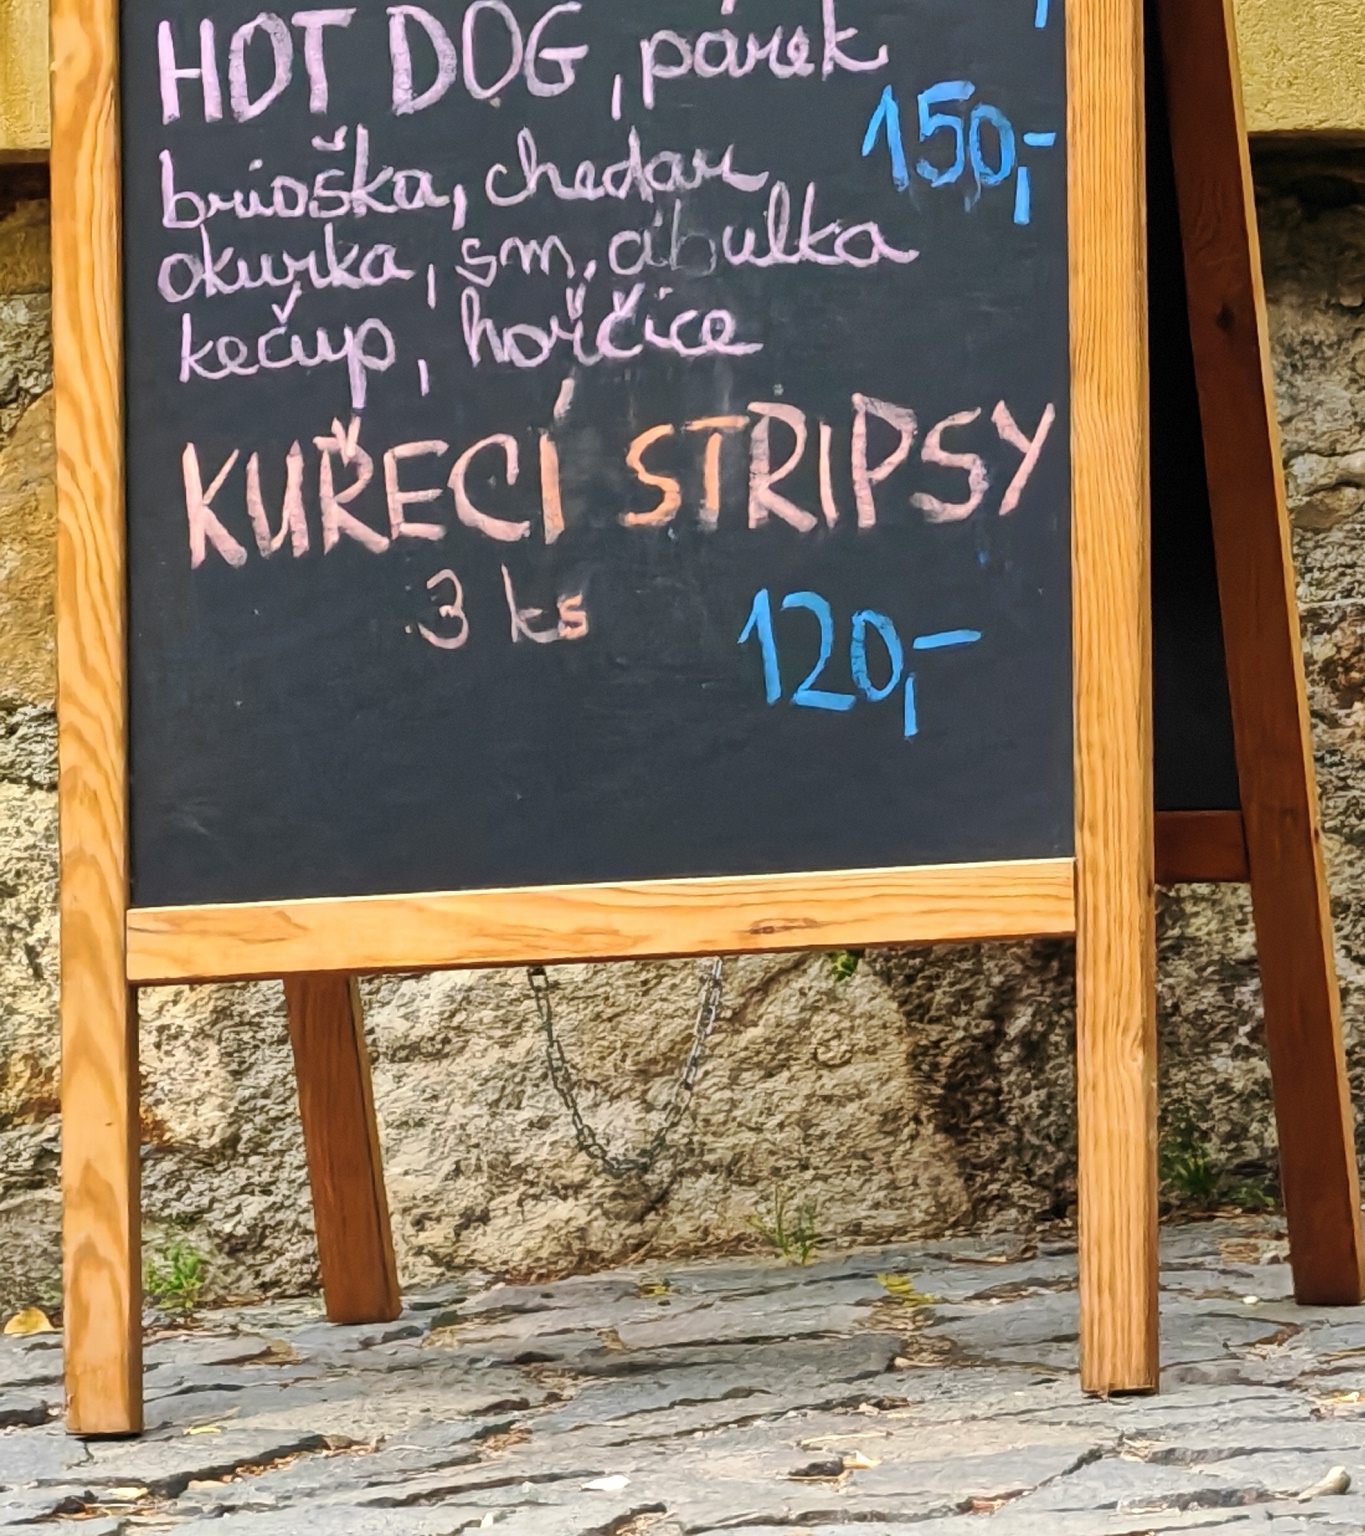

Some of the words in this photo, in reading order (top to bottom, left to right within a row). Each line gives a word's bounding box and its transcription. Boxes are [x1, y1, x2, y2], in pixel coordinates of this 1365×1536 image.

[158, 7, 357, 125] HOT
[461, 282, 764, 369] hořčice
[182, 377, 576, 569] KUŘECÍ
[618, 392, 1057, 532] STRIPSY
[406, 568, 469, 651] 3
[500, 565, 590, 645] ks
